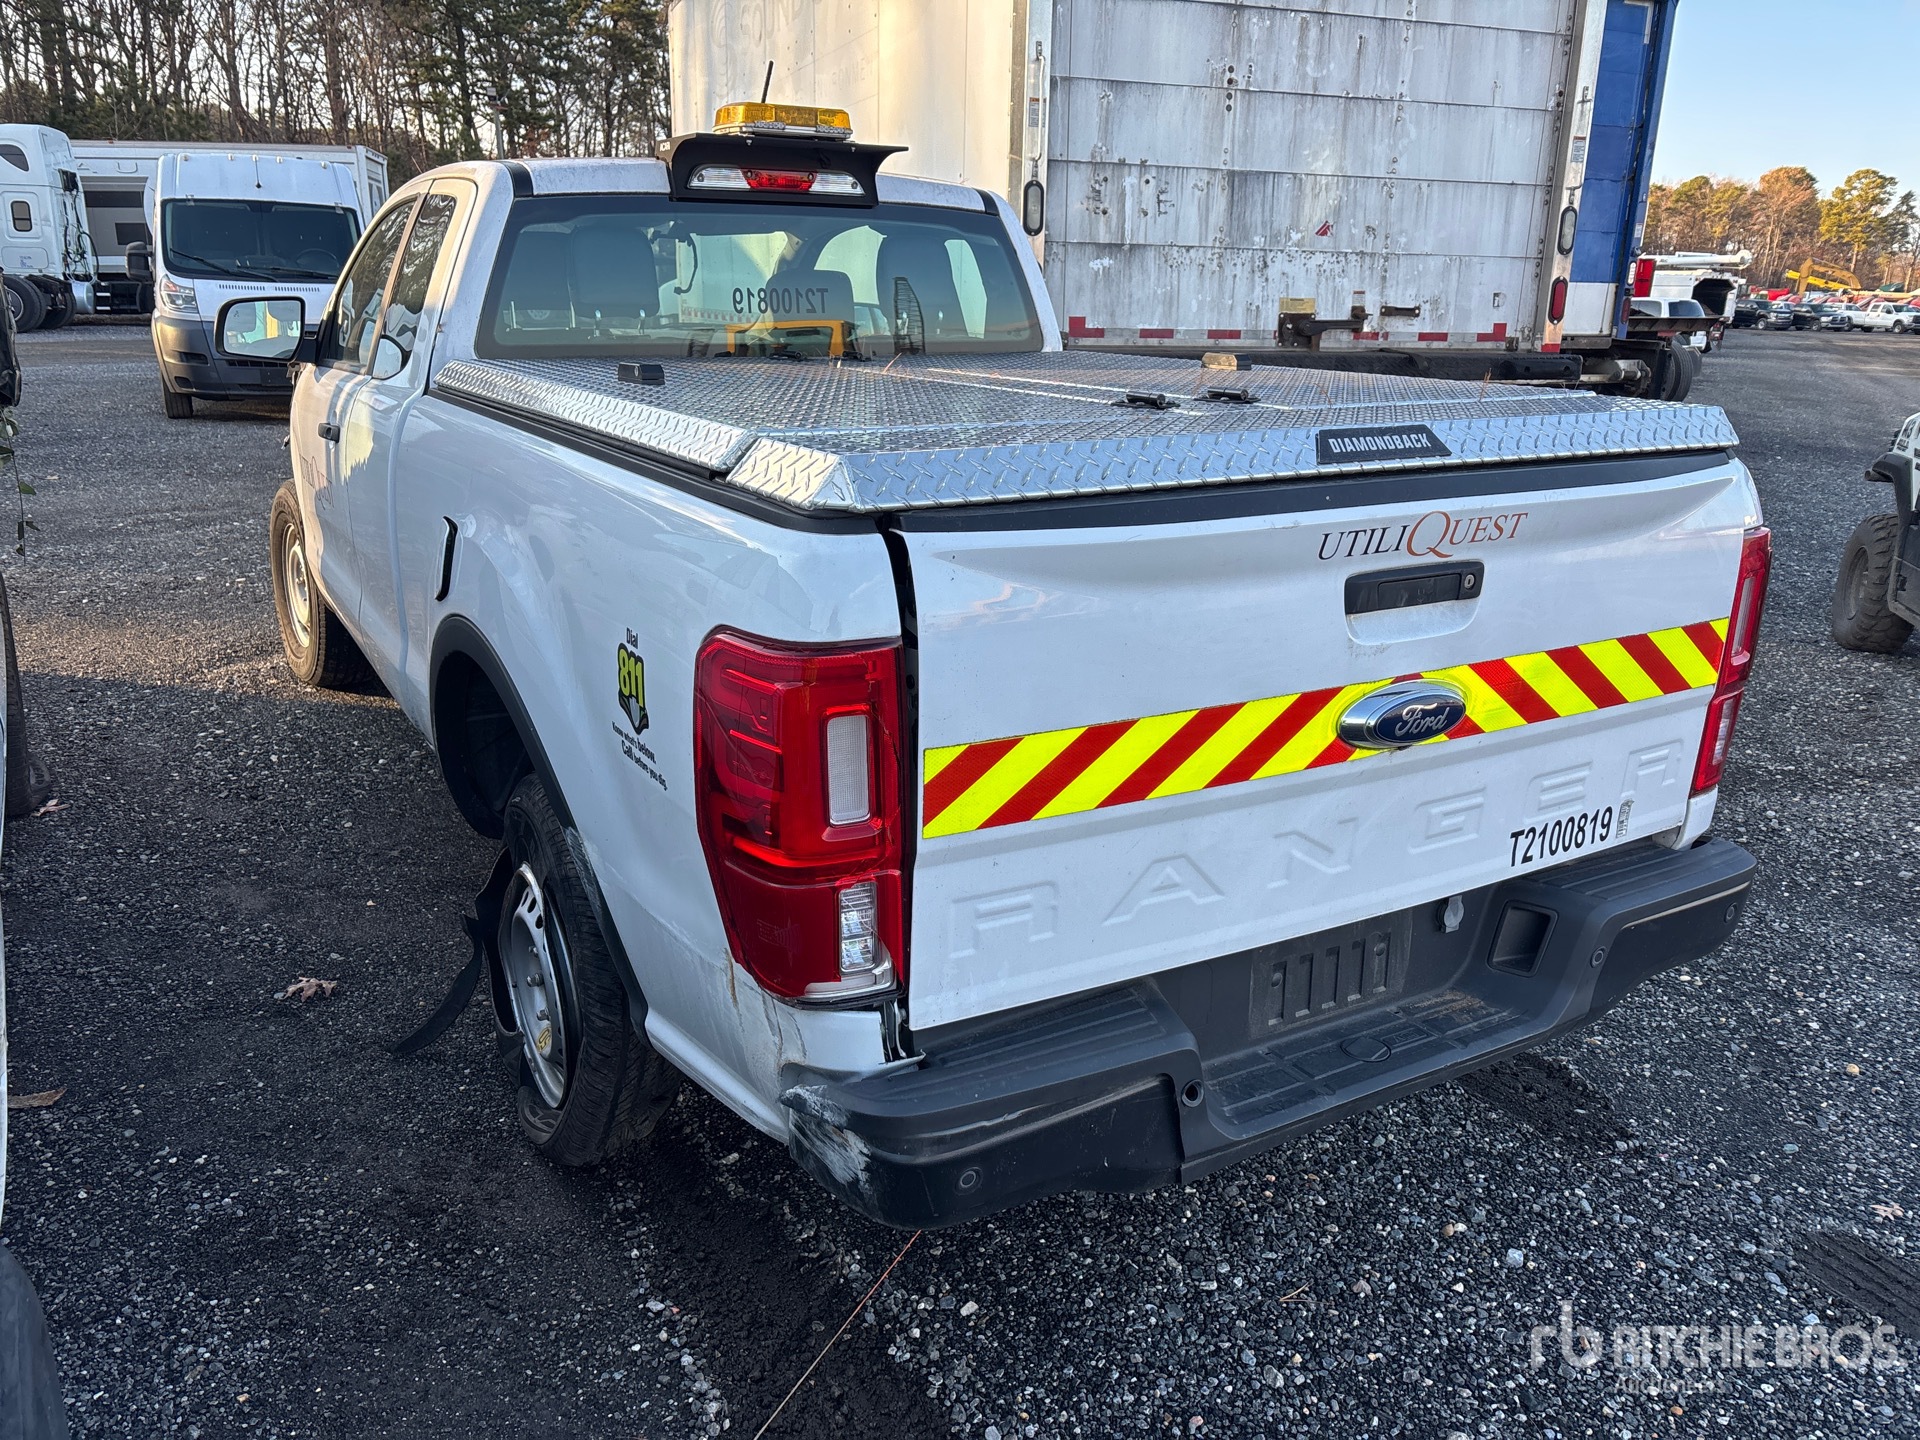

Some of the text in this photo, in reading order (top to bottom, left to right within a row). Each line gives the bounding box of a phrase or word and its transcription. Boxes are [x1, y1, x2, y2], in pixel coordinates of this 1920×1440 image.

[1328, 433, 1431, 453] DIAMONDBACK
[626, 627, 639, 650] Dial
[618, 645, 645, 708] 811
[1394, 702, 1451, 737] Ford
[948, 738, 1684, 958] RANGER
[1509, 805, 1613, 867] T2100819
